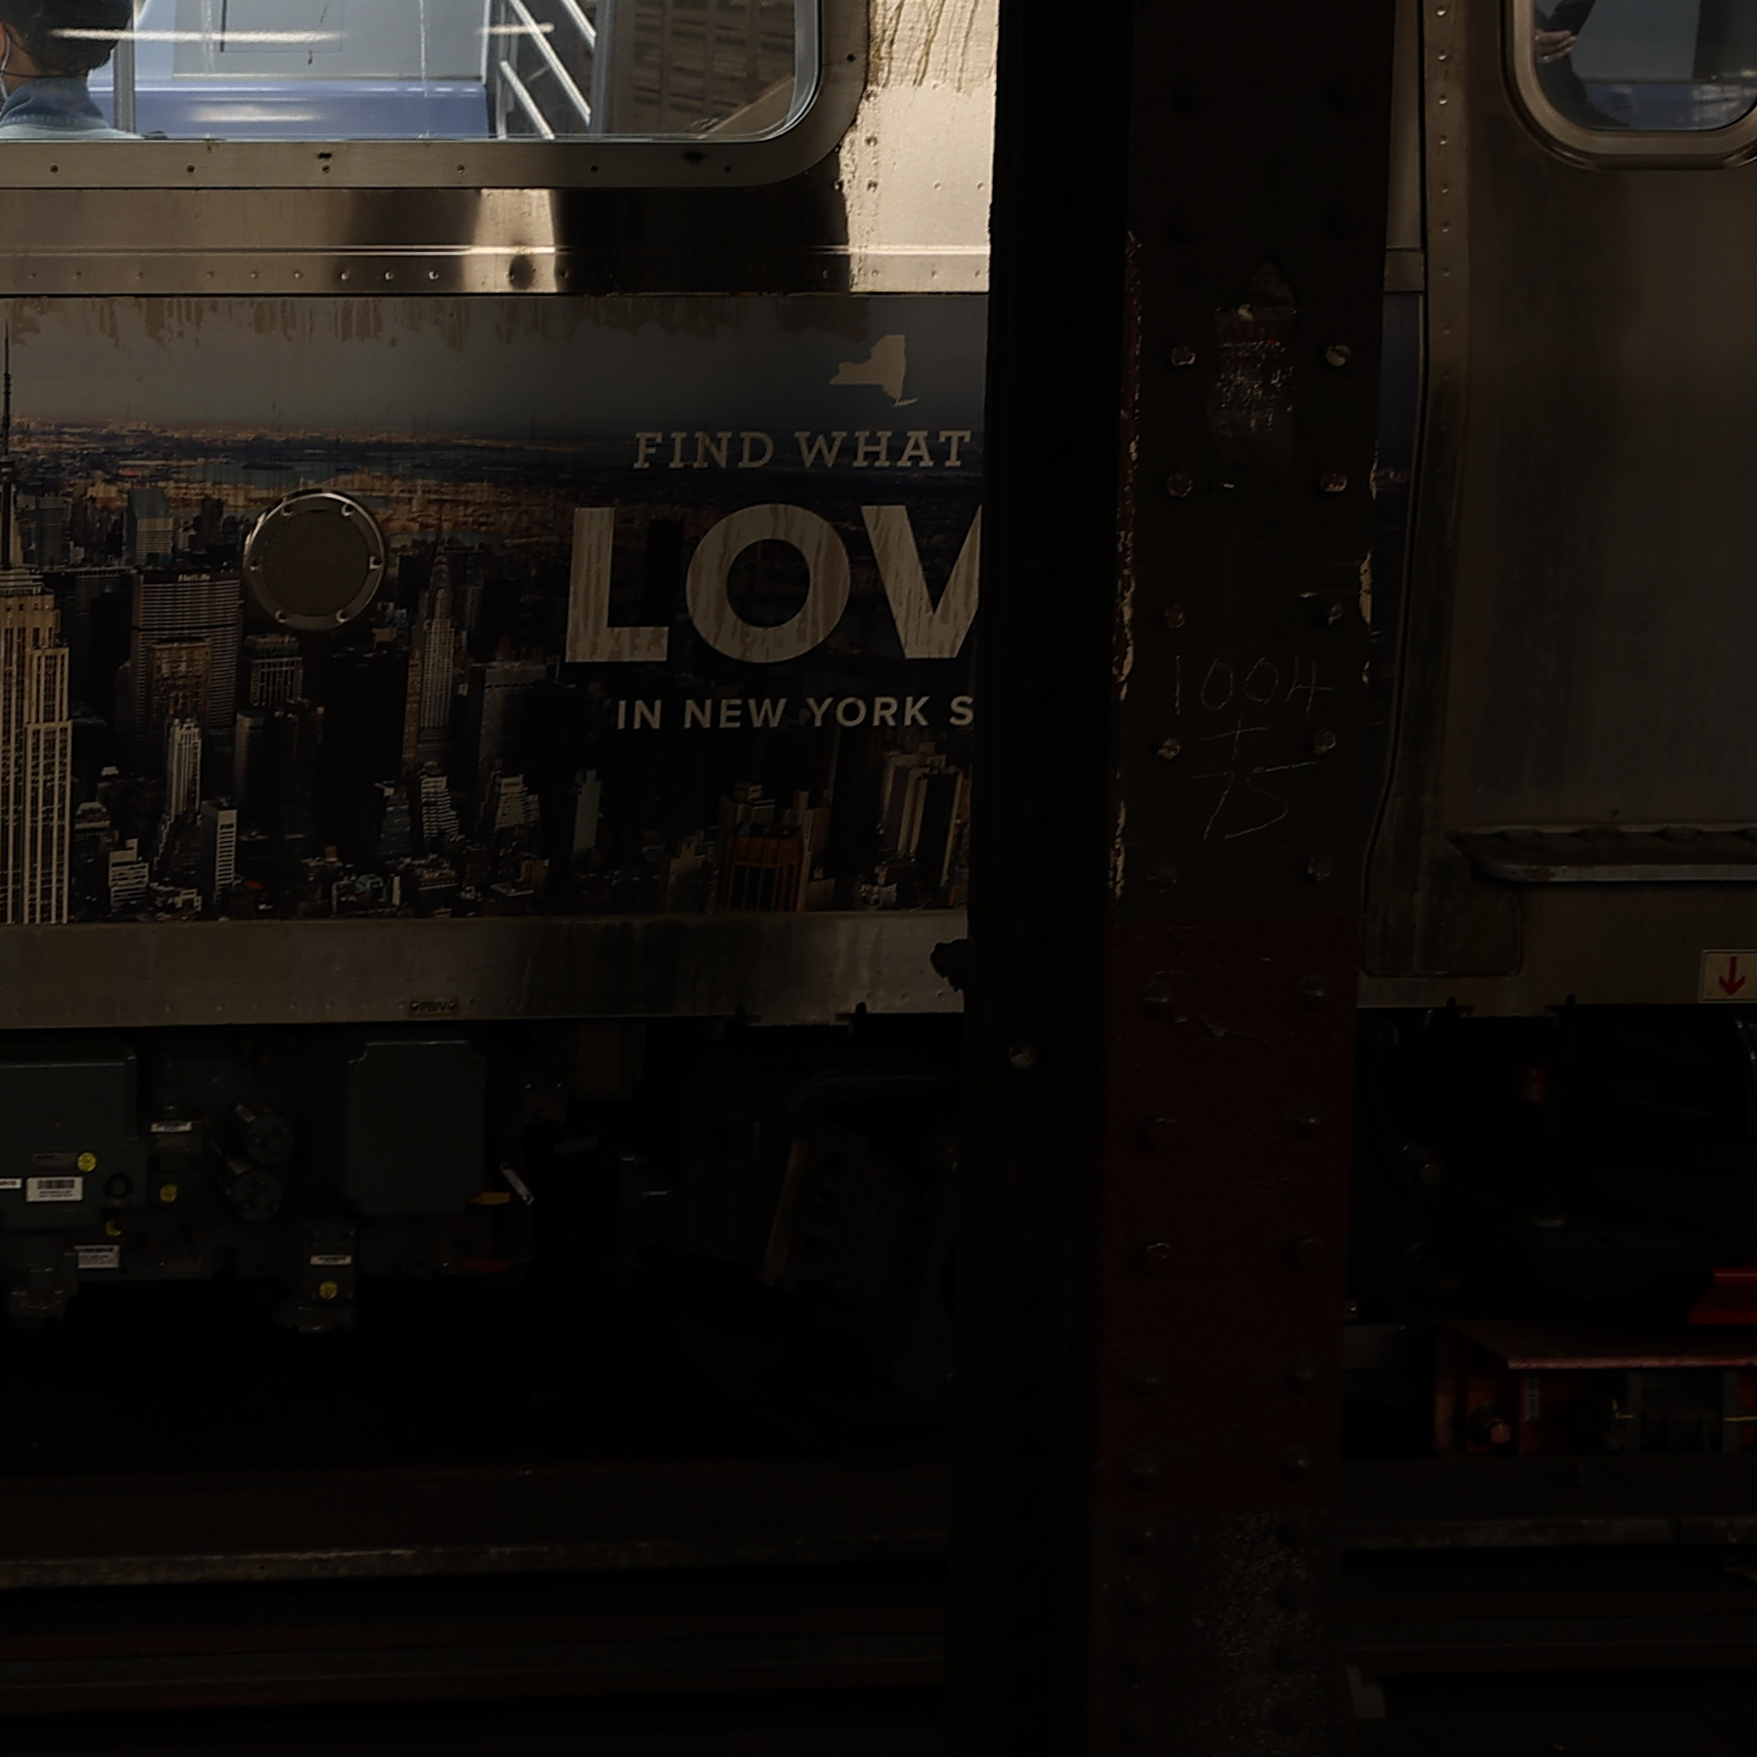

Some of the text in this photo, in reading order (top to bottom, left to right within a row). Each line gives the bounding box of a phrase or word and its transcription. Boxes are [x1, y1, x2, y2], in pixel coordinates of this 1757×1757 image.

[632, 429, 973, 470] FIND WHAT
[564, 501, 984, 665] LOV
[615, 694, 976, 731] IN NEW YORK S
[1174, 655, 1335, 720] 1004
[1192, 762, 1319, 840] 75
